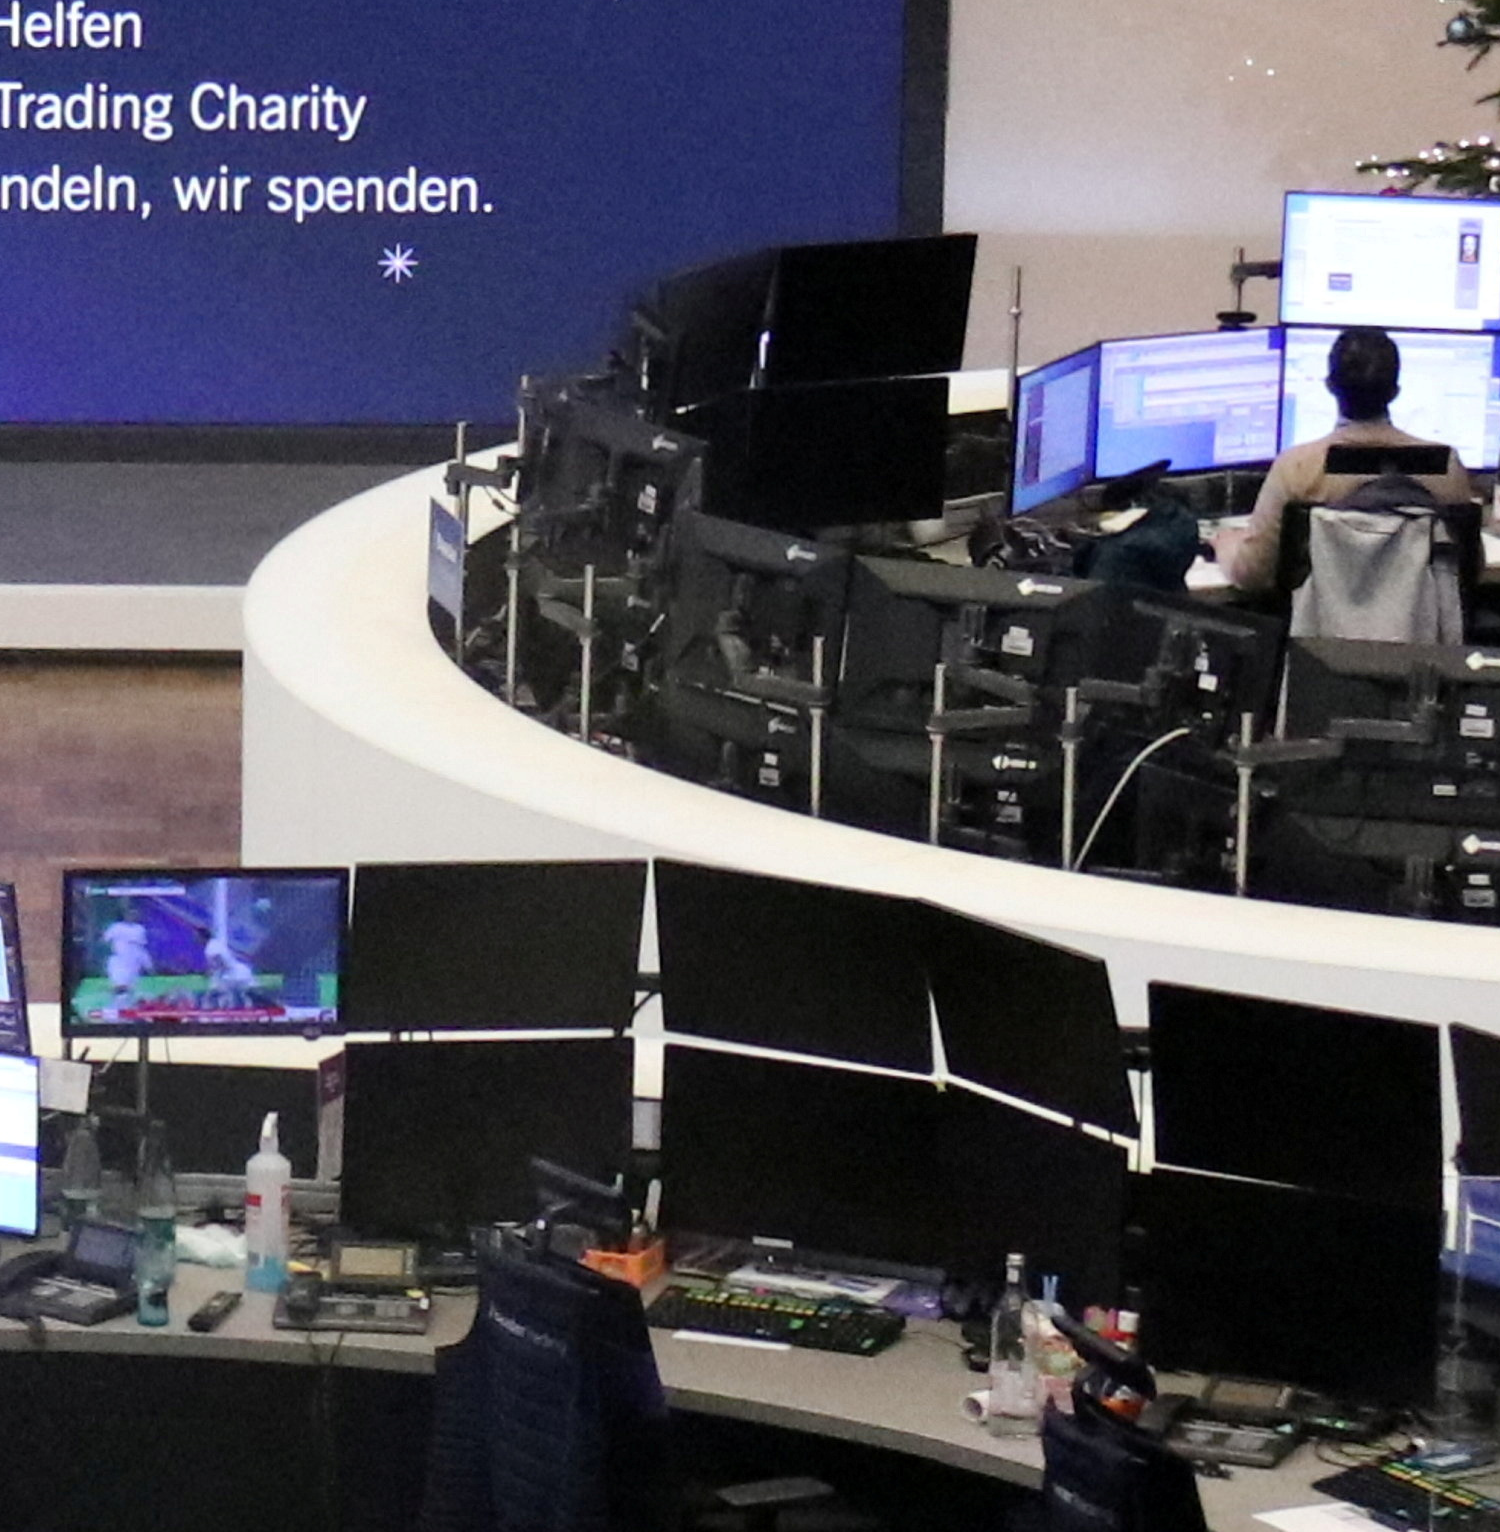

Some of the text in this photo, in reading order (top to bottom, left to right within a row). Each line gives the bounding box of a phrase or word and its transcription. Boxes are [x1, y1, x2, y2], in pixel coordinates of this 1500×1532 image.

[190, 81, 367, 142] Charity
[172, 164, 252, 212] wir
[267, 165, 493, 224] spenden.
